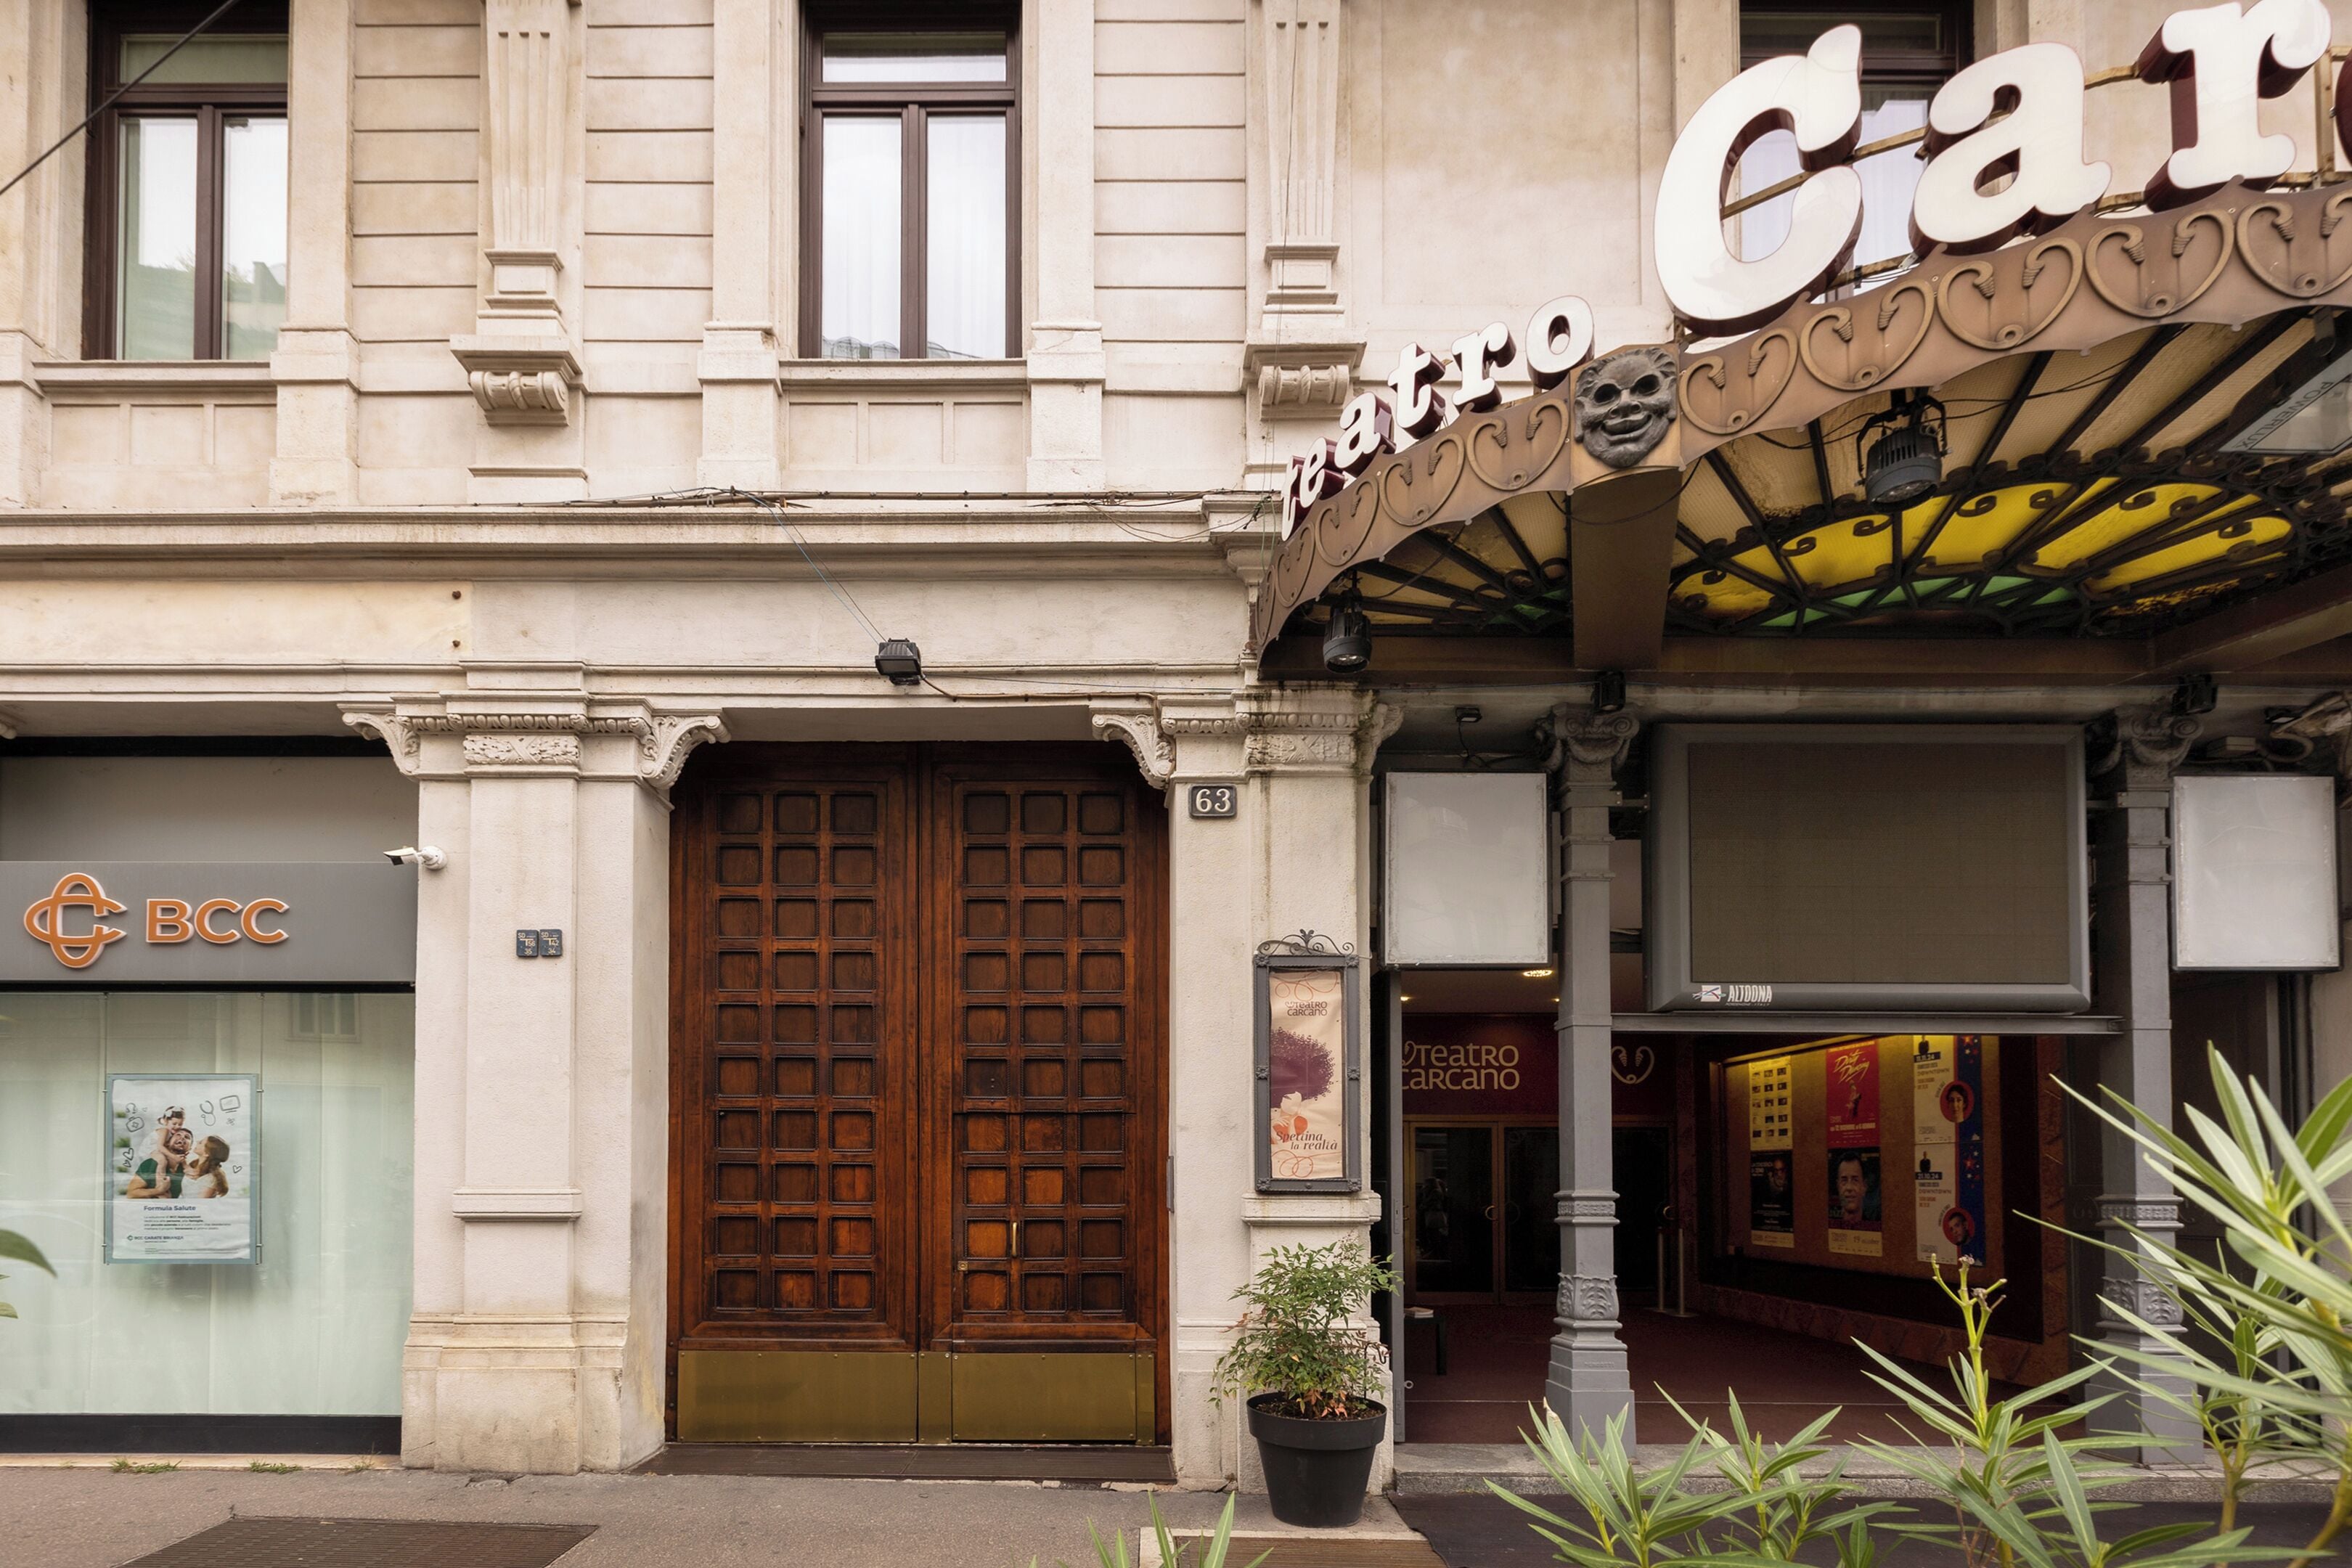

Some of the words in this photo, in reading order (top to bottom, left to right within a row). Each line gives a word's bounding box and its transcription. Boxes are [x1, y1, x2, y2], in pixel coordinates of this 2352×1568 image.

[1281, 295, 1595, 542] teatro
[1654, 0, 2352, 323] Car
[2231, 381, 2334, 449] POWERLUX
[1196, 788, 1231, 812] 63
[146, 898, 290, 944] BCC
[1728, 985, 1772, 1003] ALTOONA
[1276, 1131, 1323, 1143] Spettina
[1303, 1139, 1338, 1150] realtà
